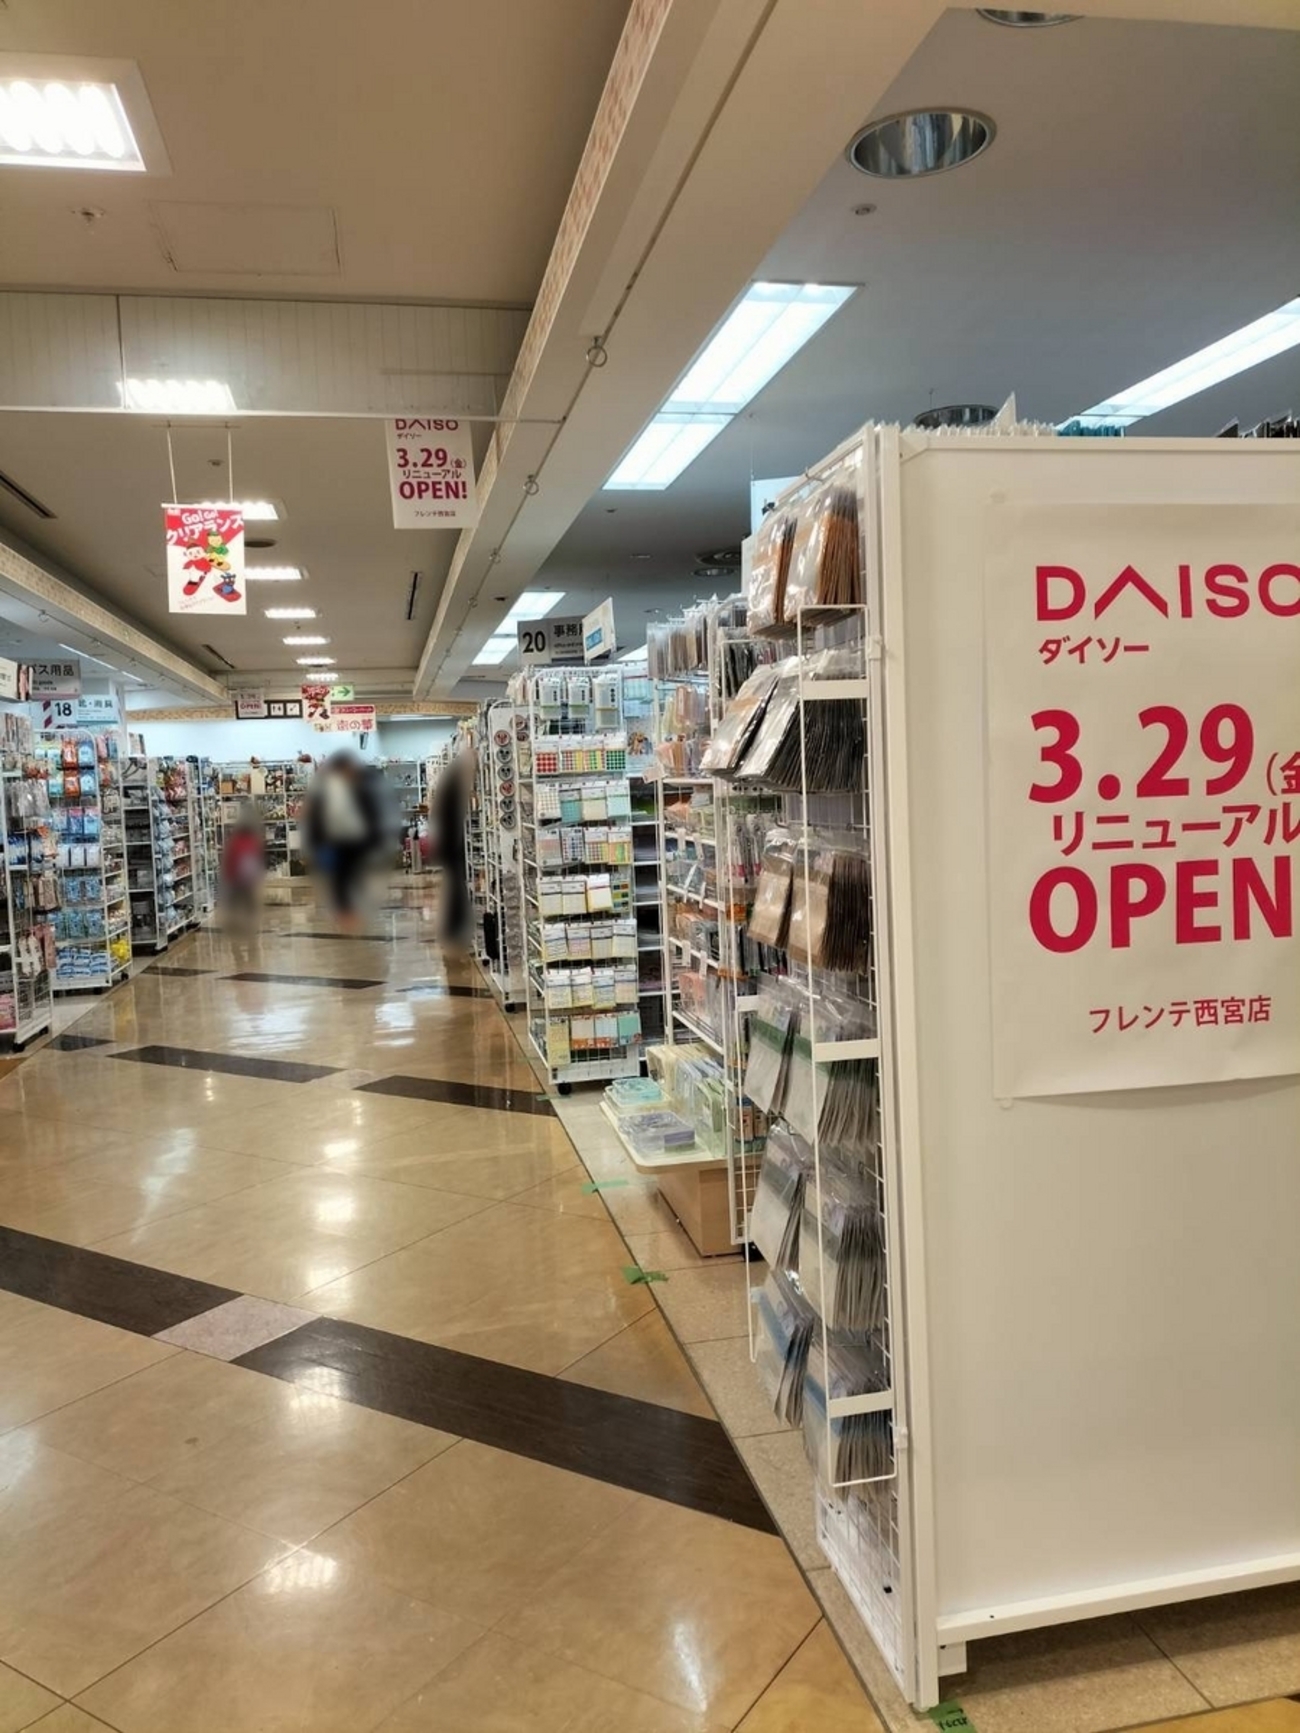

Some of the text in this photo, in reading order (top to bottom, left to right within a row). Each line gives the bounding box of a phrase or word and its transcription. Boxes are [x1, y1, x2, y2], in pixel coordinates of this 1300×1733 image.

[395, 419, 459, 431] DAISO
[403, 469, 461, 479] リニューアル
[399, 481, 468, 500] OPEN!
[166, 515, 244, 546] クリアランス
[1036, 563, 1300, 621] DAISO
[522, 630, 546, 653] 20
[1038, 635, 1149, 665] ダイソー
[55, 703, 72, 716] 18
[1028, 702, 1254, 804] 3.29
[1053, 801, 1300, 857] リニューアル
[1029, 855, 1292, 954] OPEN
[1089, 995, 1272, 1033] フレンテ西宮店
